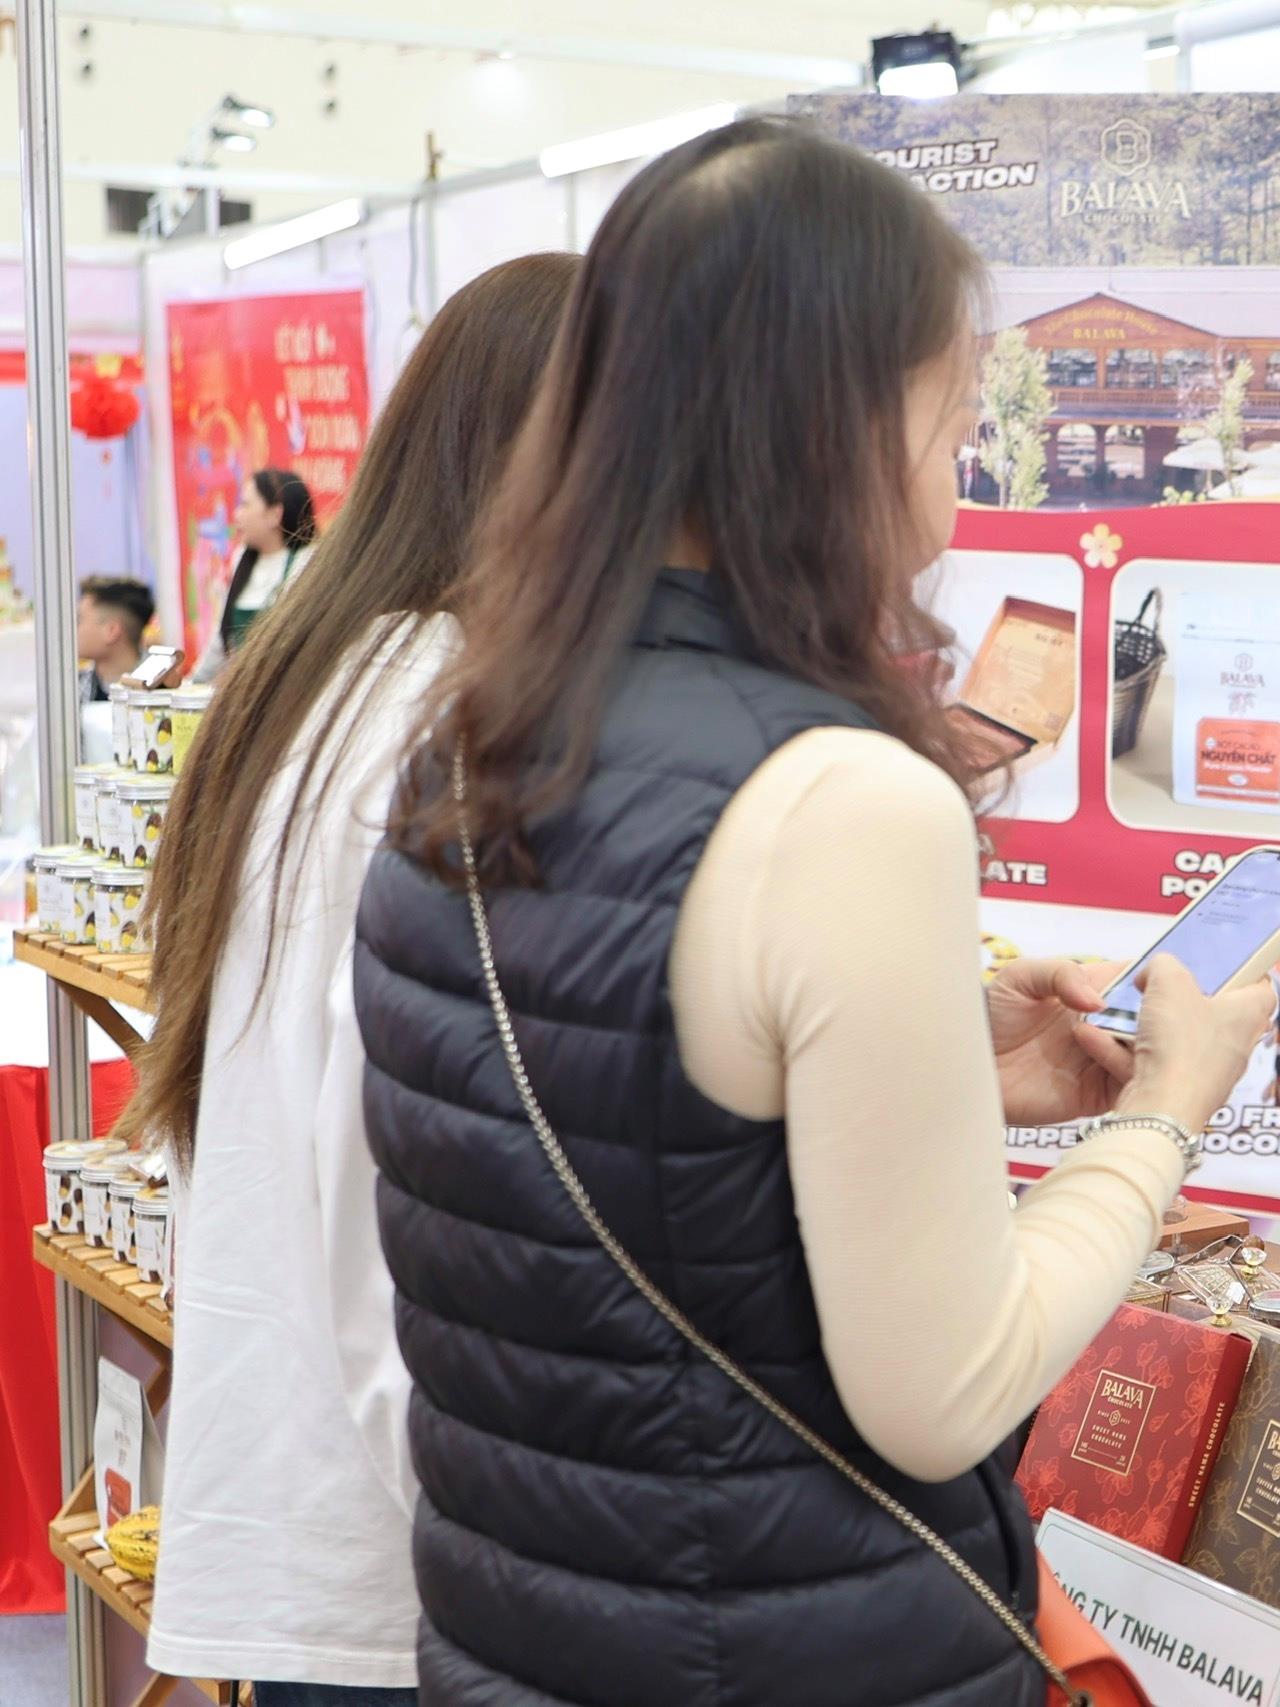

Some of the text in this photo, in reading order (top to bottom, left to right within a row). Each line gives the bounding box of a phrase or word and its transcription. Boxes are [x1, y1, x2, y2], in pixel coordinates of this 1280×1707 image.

[909, 162, 1038, 193] ACTION
[1060, 181, 1192, 219] BALAVA
[984, 861, 1048, 885] ATE
[1101, 1379, 1145, 1410] BALAVA
[1205, 1402, 1226, 1451] CHOCOLATE
[1088, 1599, 1119, 1631] TY
[1119, 1614, 1178, 1663] TNHH
[1176, 1643, 1265, 1706] BALAVA
